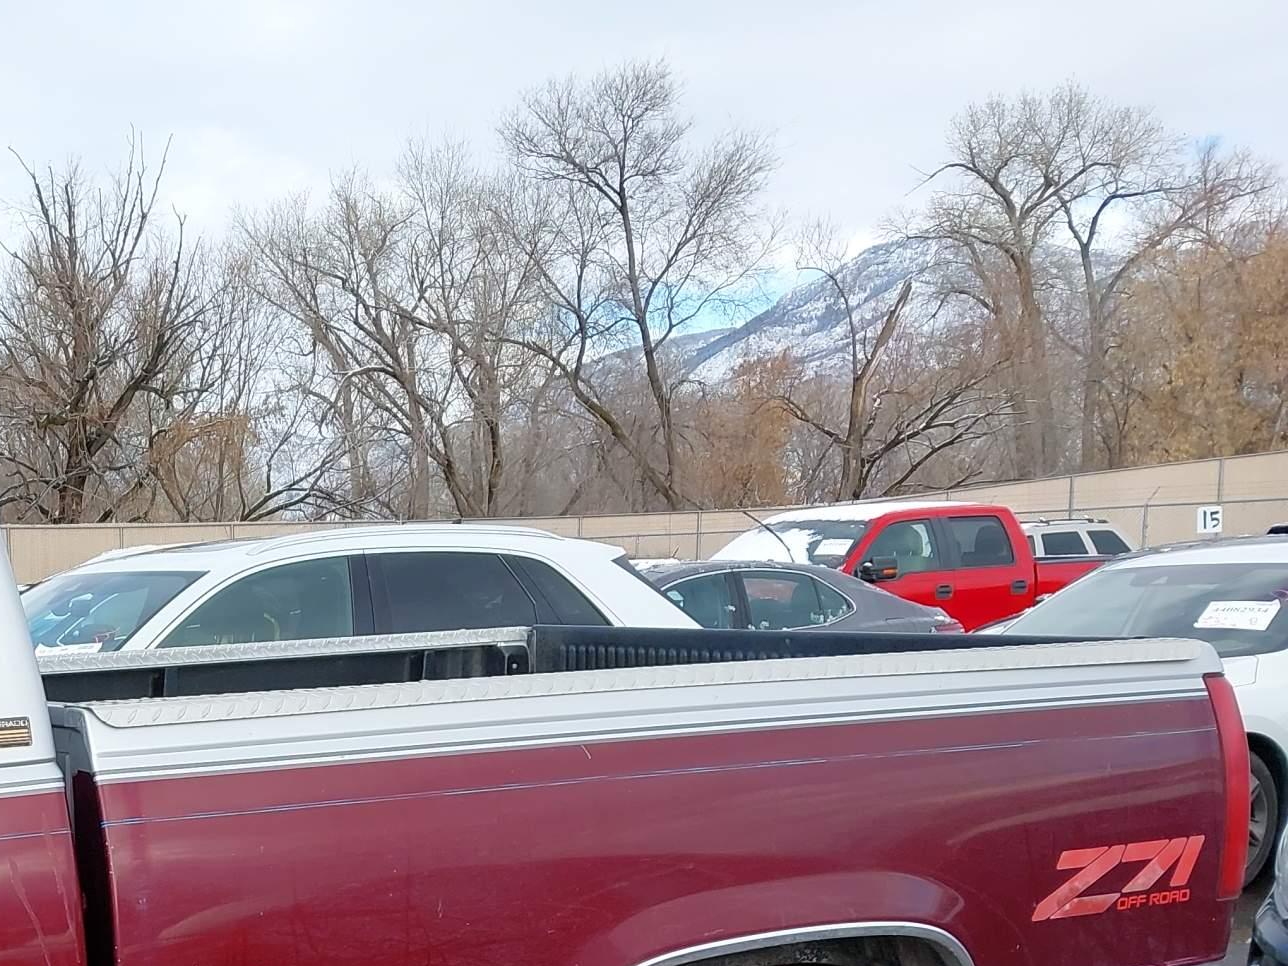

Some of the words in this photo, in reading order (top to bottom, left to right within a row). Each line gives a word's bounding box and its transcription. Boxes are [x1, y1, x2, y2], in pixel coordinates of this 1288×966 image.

[1203, 510, 1221, 530] 15
[1031, 835, 1206, 922] Z71
[1116, 893, 1147, 911] OFF
[1149, 889, 1191, 906] ROAD
